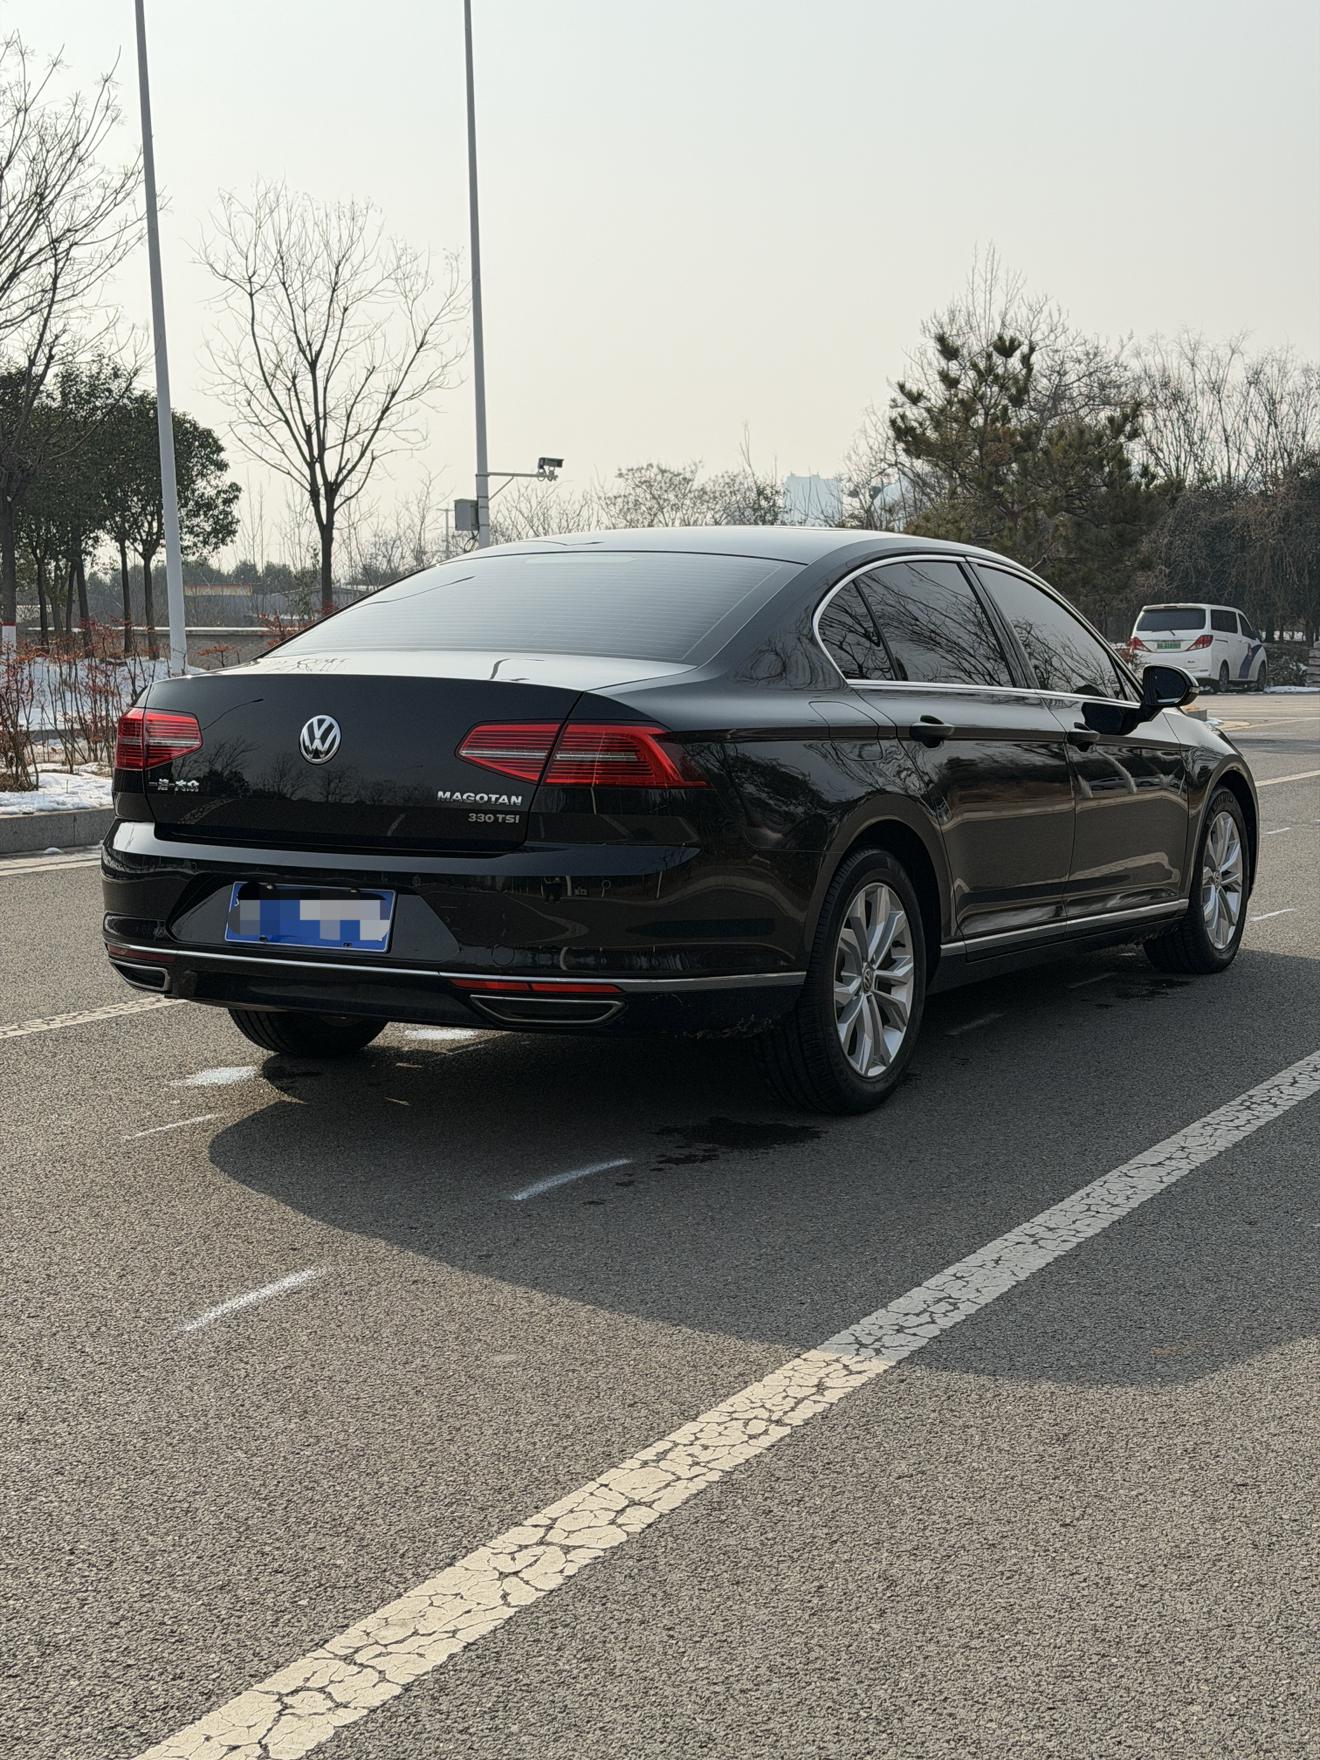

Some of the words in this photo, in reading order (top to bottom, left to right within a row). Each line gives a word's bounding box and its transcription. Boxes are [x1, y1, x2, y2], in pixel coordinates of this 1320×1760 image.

[437, 790, 522, 806] MAGOTAN
[468, 813, 494, 823] 330
[496, 814, 520, 824] TSI
